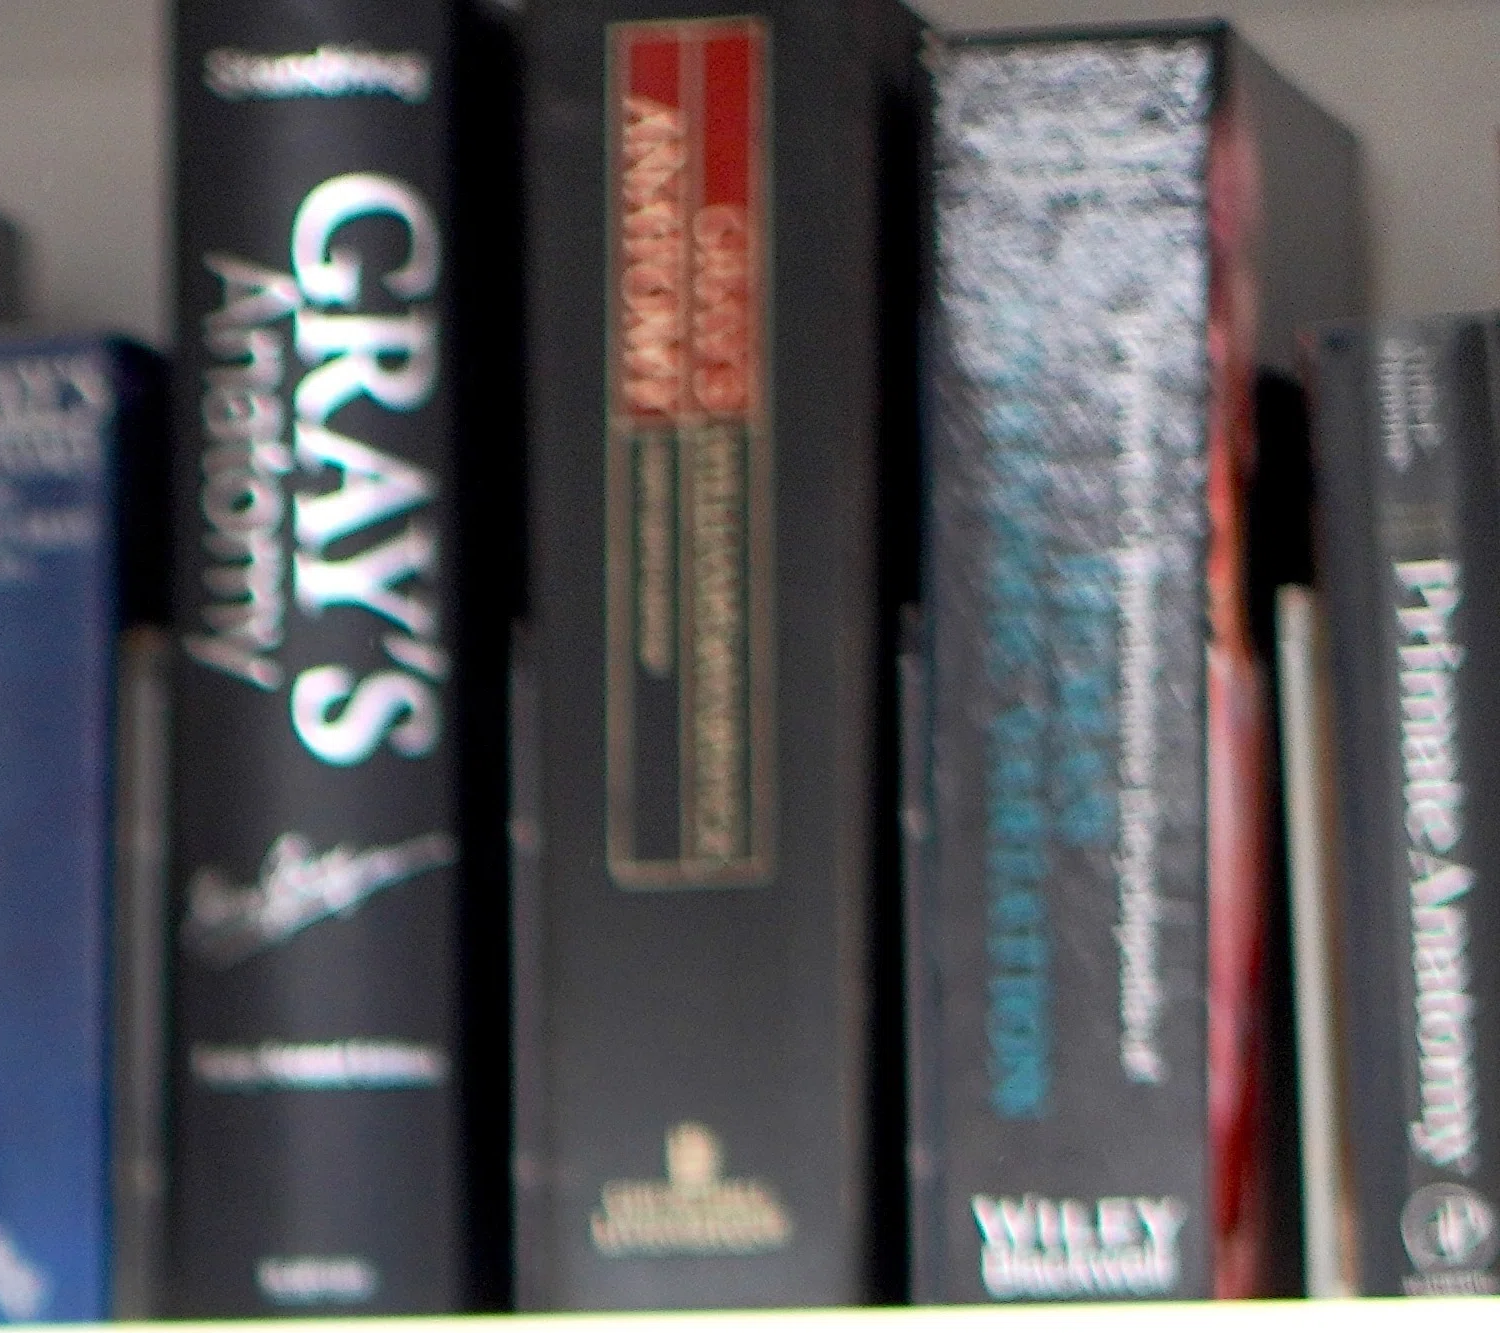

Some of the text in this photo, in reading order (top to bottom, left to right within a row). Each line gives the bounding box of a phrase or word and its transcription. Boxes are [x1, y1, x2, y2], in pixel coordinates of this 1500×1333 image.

[621, 96, 684, 420] ANATOMY
[692, 205, 752, 412] GRAY'S
[186, 253, 298, 692] Anatomy
[291, 170, 446, 768] GRAY'S
[1392, 556, 1468, 855] Primate
[1404, 846, 1476, 1176] Anatomy
[970, 1194, 1188, 1248] WILEY
